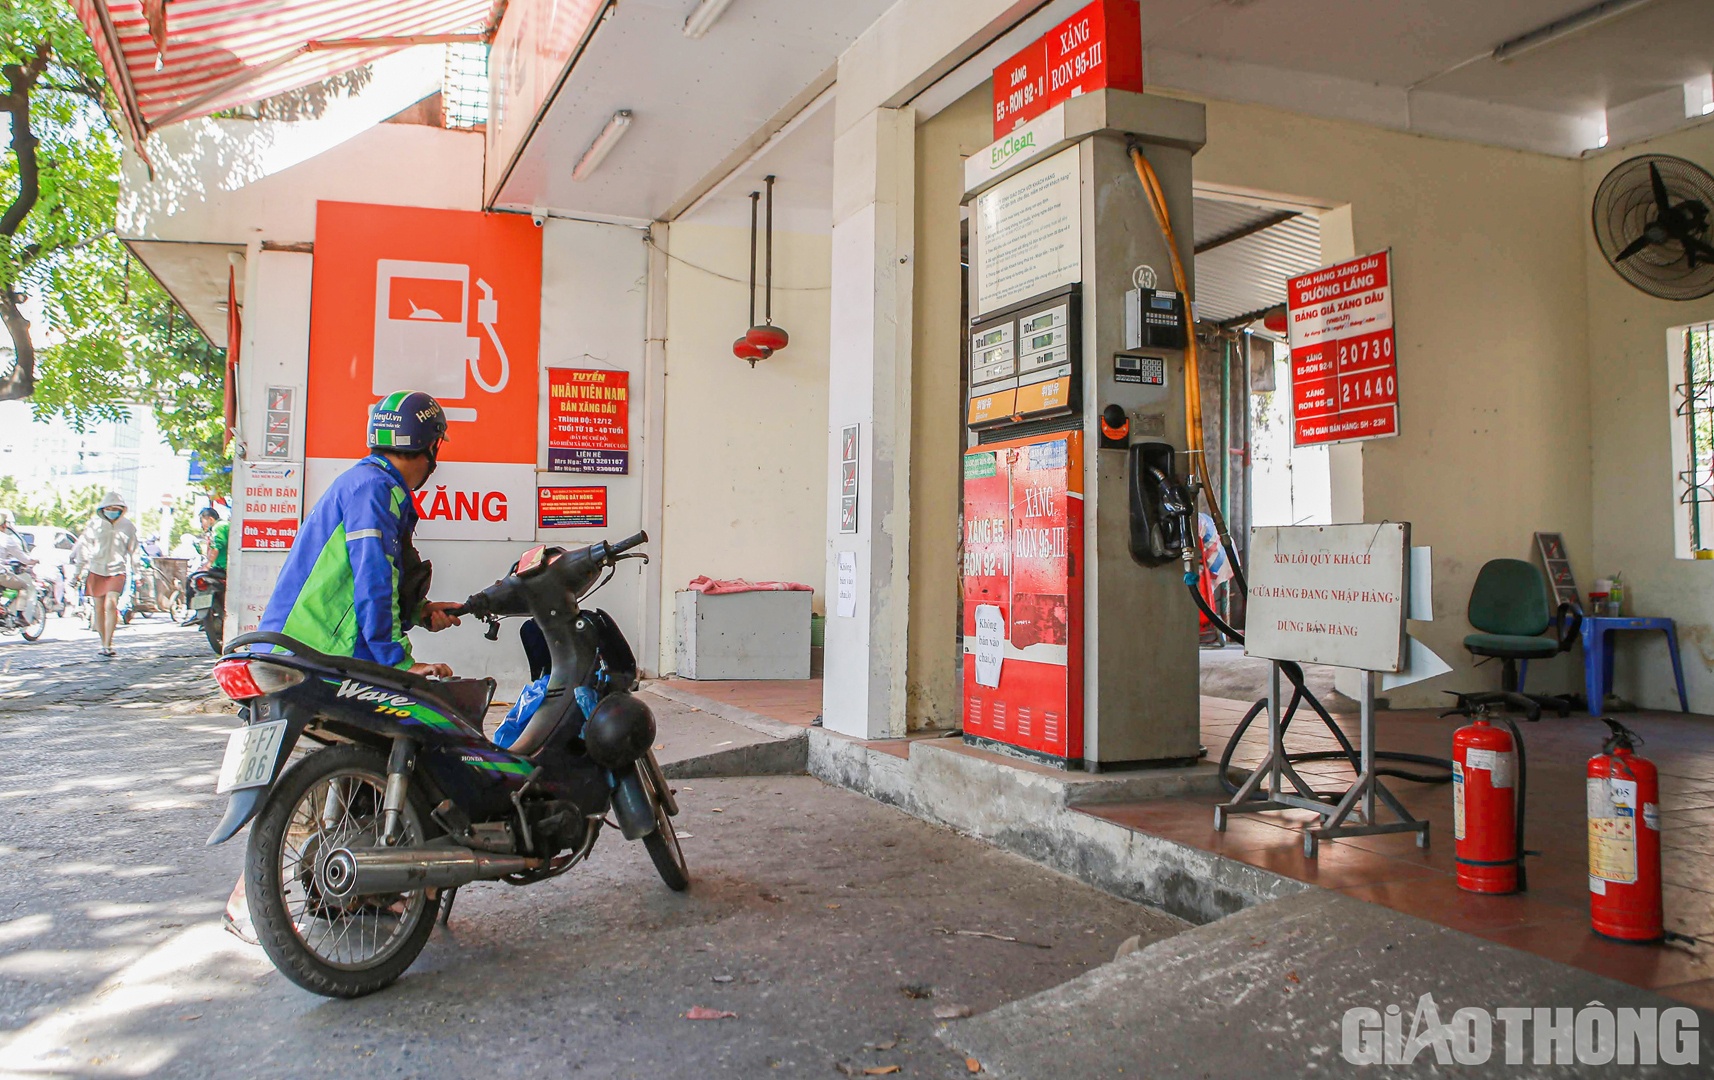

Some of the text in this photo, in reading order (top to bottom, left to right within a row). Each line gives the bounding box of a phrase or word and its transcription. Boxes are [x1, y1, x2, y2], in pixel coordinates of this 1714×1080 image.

[1060, 18, 1090, 56] XĂNG
[1051, 41, 1103, 91] RON 95-III
[1010, 65, 1027, 87] XĂNG
[996, 100, 1005, 122] E5
[1009, 91, 1024, 115] RON
[1024, 82, 1034, 103] 92
[1038, 76, 1044, 97] II
[991, 131, 1034, 165] EnClean
[1138, 270, 1152, 289] 43
[1296, 258, 1378, 289] CỬA HÀNG XĂNG DẦU
[1301, 283, 1340, 303] ĐƯỜNG
[1295, 291, 1384, 322] BẢNG GIÁ XĂNG DẦU
[1340, 337, 1391, 365] 20730
[572, 370, 606, 381] TUYỂN
[551, 382, 626, 401] NHÂN VIÊN NAM
[1342, 375, 1394, 403] 21440
[560, 400, 617, 414] BÁN XĂNG DẦU
[1298, 401, 1314, 411] RON
[373, 412, 402, 422] HeyU.vn
[558, 415, 579, 423] TRÌNH
[593, 417, 612, 425] 12/12
[558, 424, 574, 432] TUỔI
[575, 425, 585, 433] TỪ
[1315, 425, 1329, 435] GIAN
[576, 450, 591, 458] LIÊN
[246, 484, 273, 497] ĐIỂM
[1025, 480, 1054, 517] XĂNG
[246, 500, 296, 513] BẢO HIỂM
[410, 485, 508, 522] XĂNG
[266, 527, 277, 536] Xe
[279, 527, 297, 537] máy
[967, 516, 1004, 544] XĂNG E5
[255, 539, 285, 547] Tài sản
[1016, 527, 1065, 558] RON 95-III
[963, 552, 982, 577] RON
[983, 552, 996, 576] 92
[1003, 552, 1009, 576] II
[1292, 549, 1308, 564] LỖI
[1310, 552, 1332, 566] QUÝ
[1333, 552, 1371, 564] KHÁCH
[1252, 584, 1393, 603] CỬA HÀNG ĐANG NHẬP HÀNG
[979, 618, 997, 632] Không
[1306, 620, 1326, 633] BÁN
[1328, 622, 1358, 636] HÀNG
[979, 635, 1000, 647] bán vào
[336, 679, 417, 706] Wave
[374, 705, 412, 718] 110
[1615, 788, 1630, 798] 05
